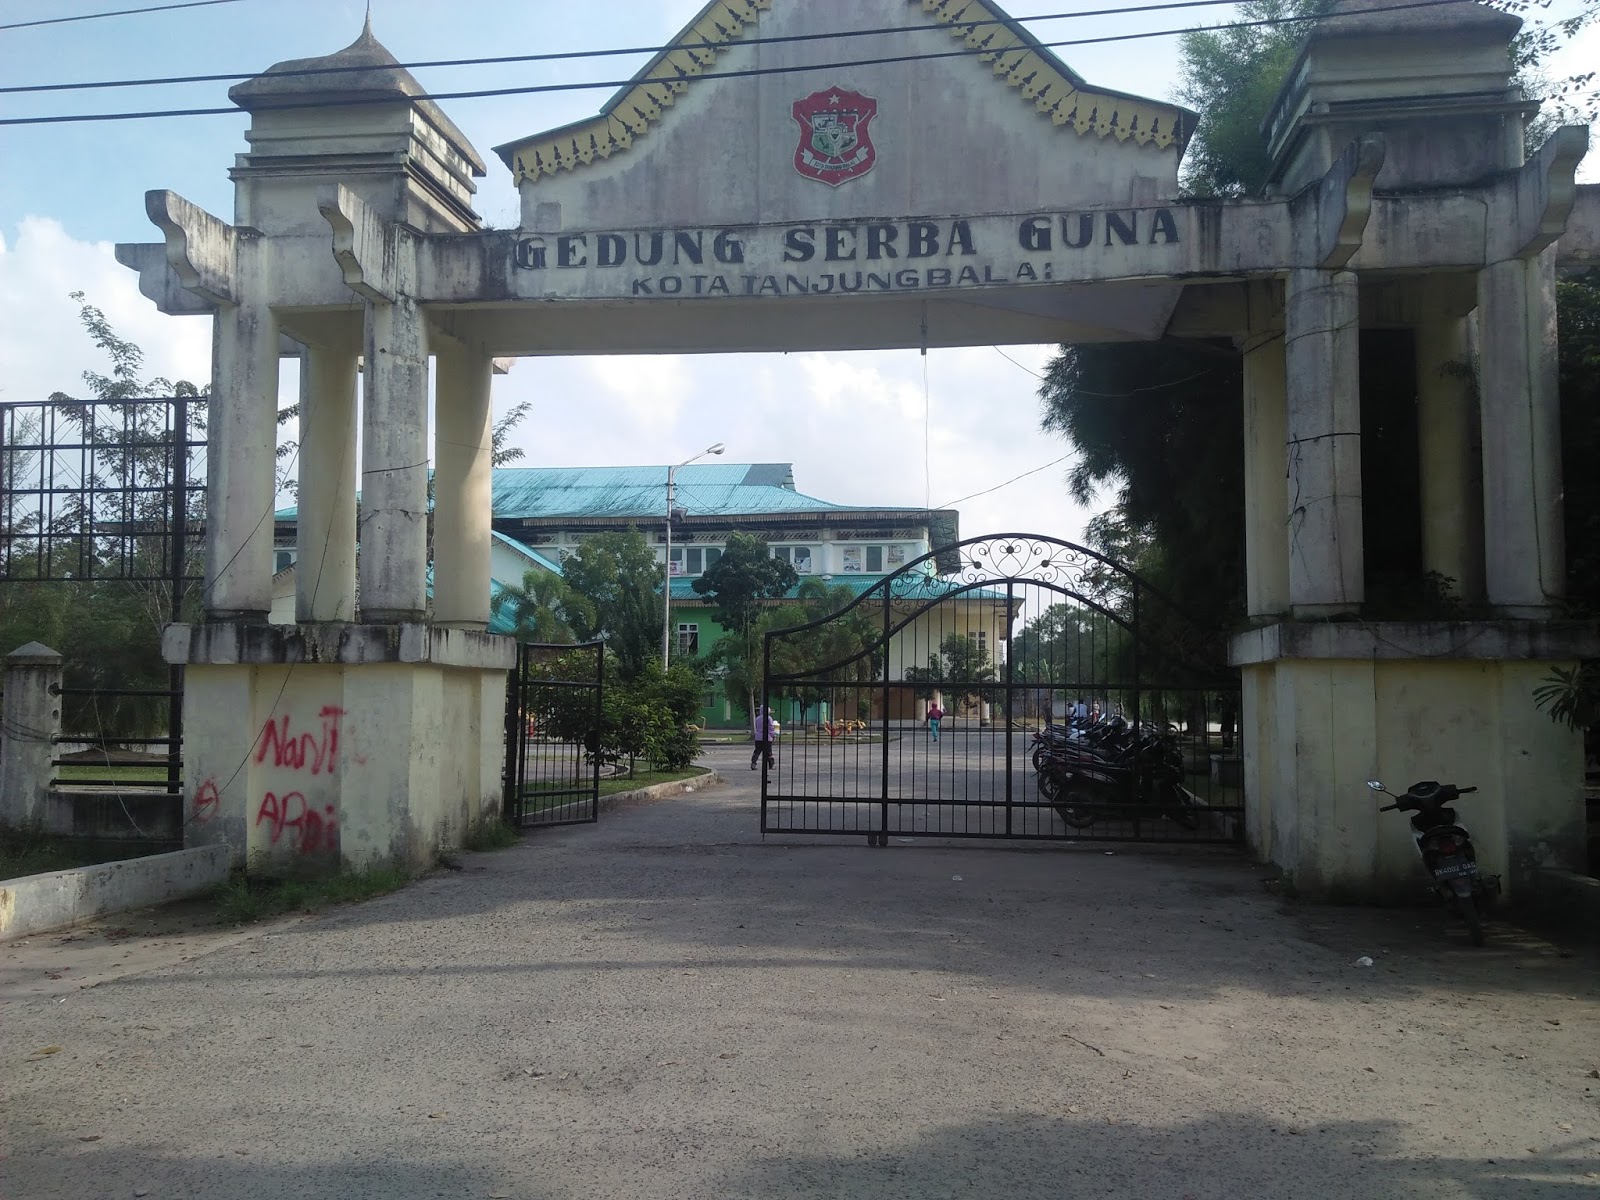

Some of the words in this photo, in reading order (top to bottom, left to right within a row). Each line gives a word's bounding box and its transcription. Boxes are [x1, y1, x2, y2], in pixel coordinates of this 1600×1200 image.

[517, 231, 744, 269] GEDUNG
[783, 220, 977, 263] SERBA
[1019, 209, 1180, 251] GUNA
[632, 275, 730, 295] KOTA
